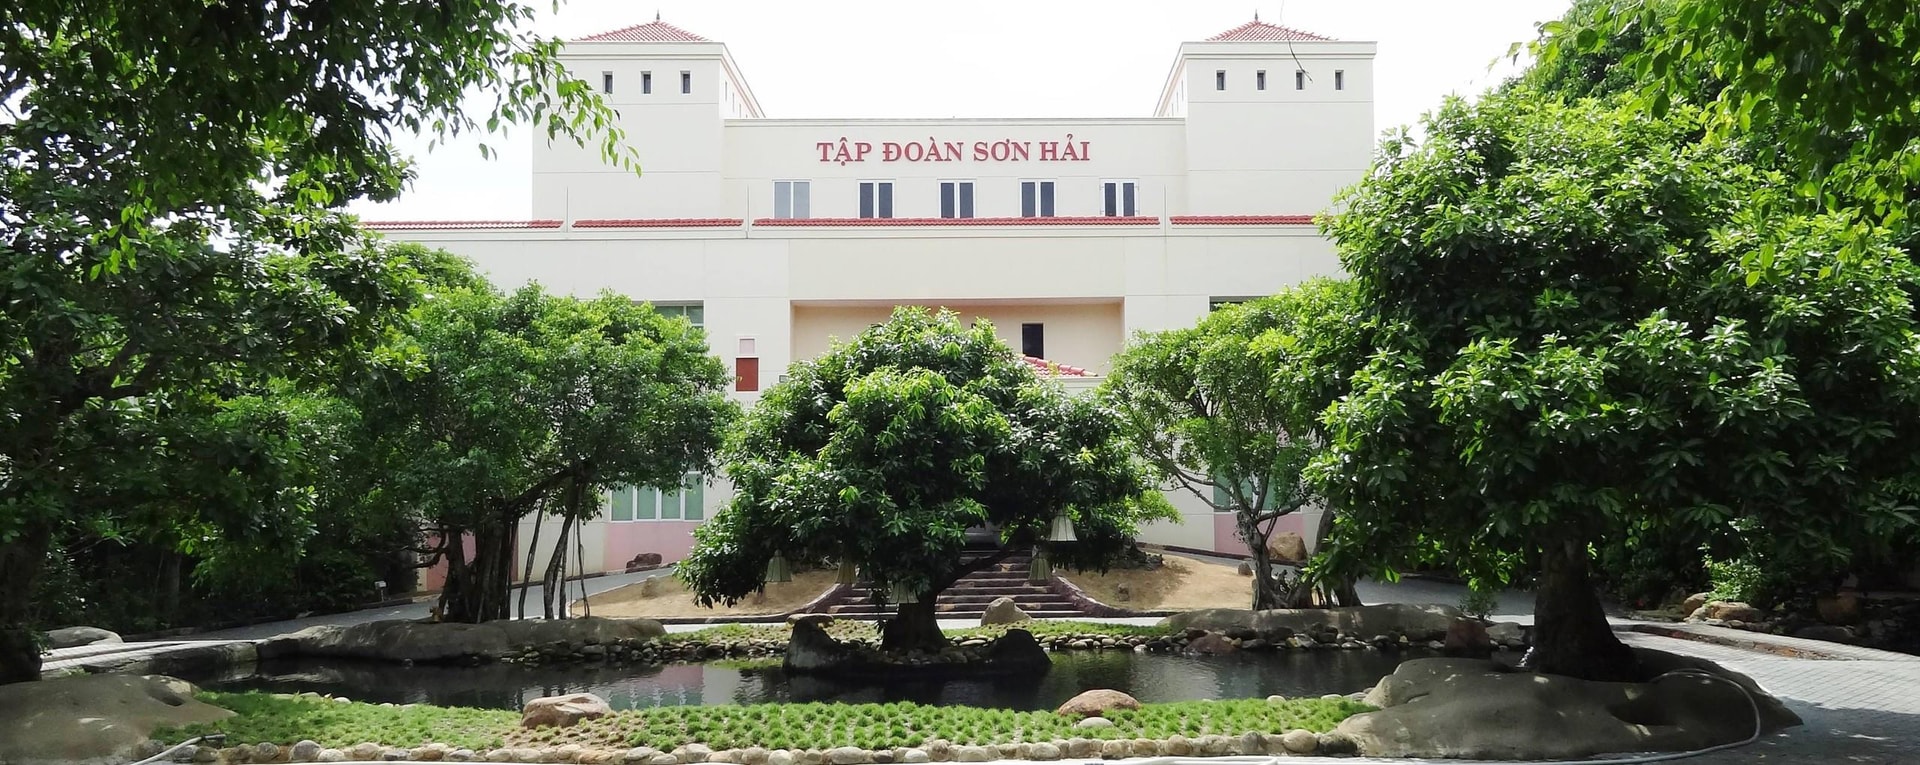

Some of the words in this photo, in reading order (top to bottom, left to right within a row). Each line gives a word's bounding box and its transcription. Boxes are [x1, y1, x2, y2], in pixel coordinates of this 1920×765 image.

[816, 136, 873, 167] TẬP
[882, 136, 964, 162] ĐOÀN
[973, 138, 1031, 162] SƠN
[1039, 133, 1091, 161] HẢI
